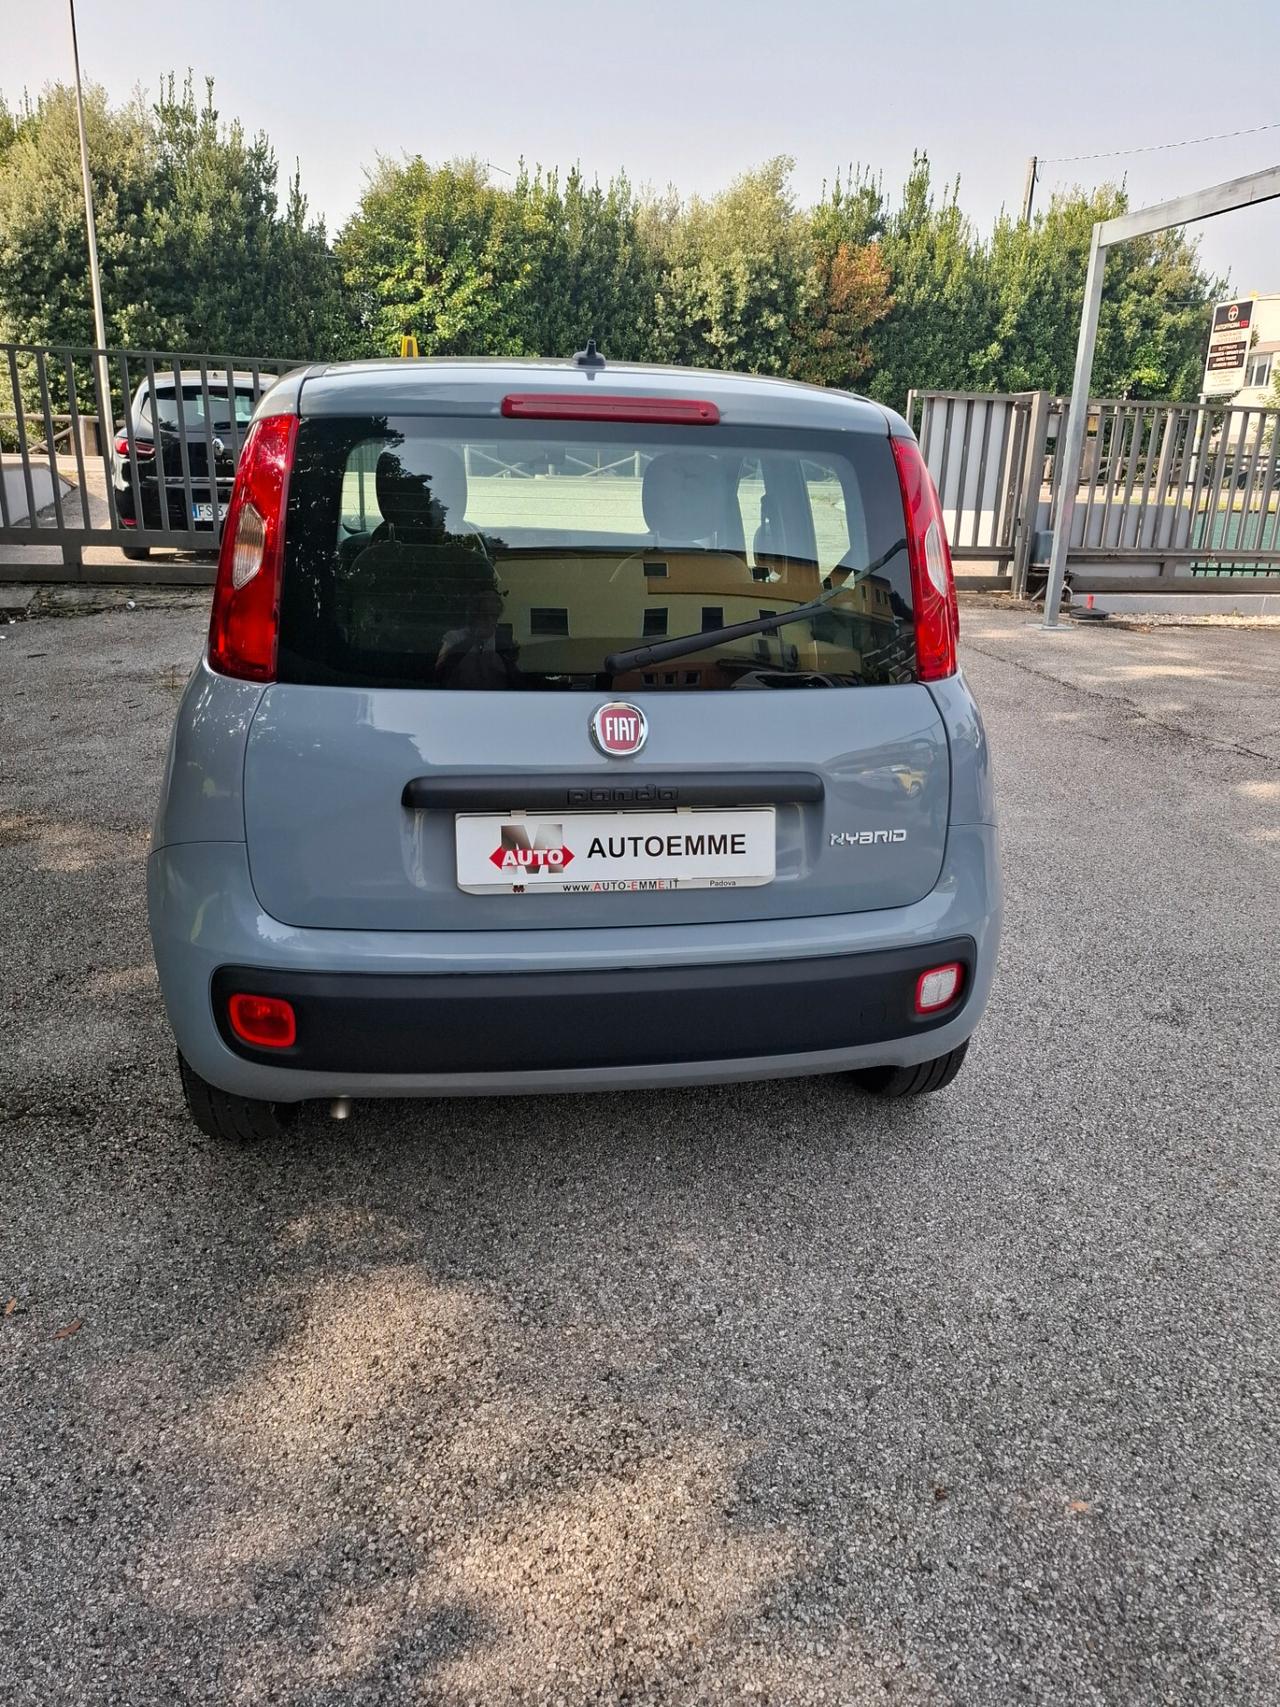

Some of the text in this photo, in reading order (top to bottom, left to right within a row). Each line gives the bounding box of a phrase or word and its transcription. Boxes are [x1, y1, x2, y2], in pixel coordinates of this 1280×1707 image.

[605, 717, 637, 741] FIAT
[568, 784, 679, 805] panda
[587, 834, 746, 858] AUTOEMME
[830, 829, 907, 846] HYBRID
[502, 850, 564, 866] AUTO
[563, 879, 679, 891] www.AUTO-EMME.IT
